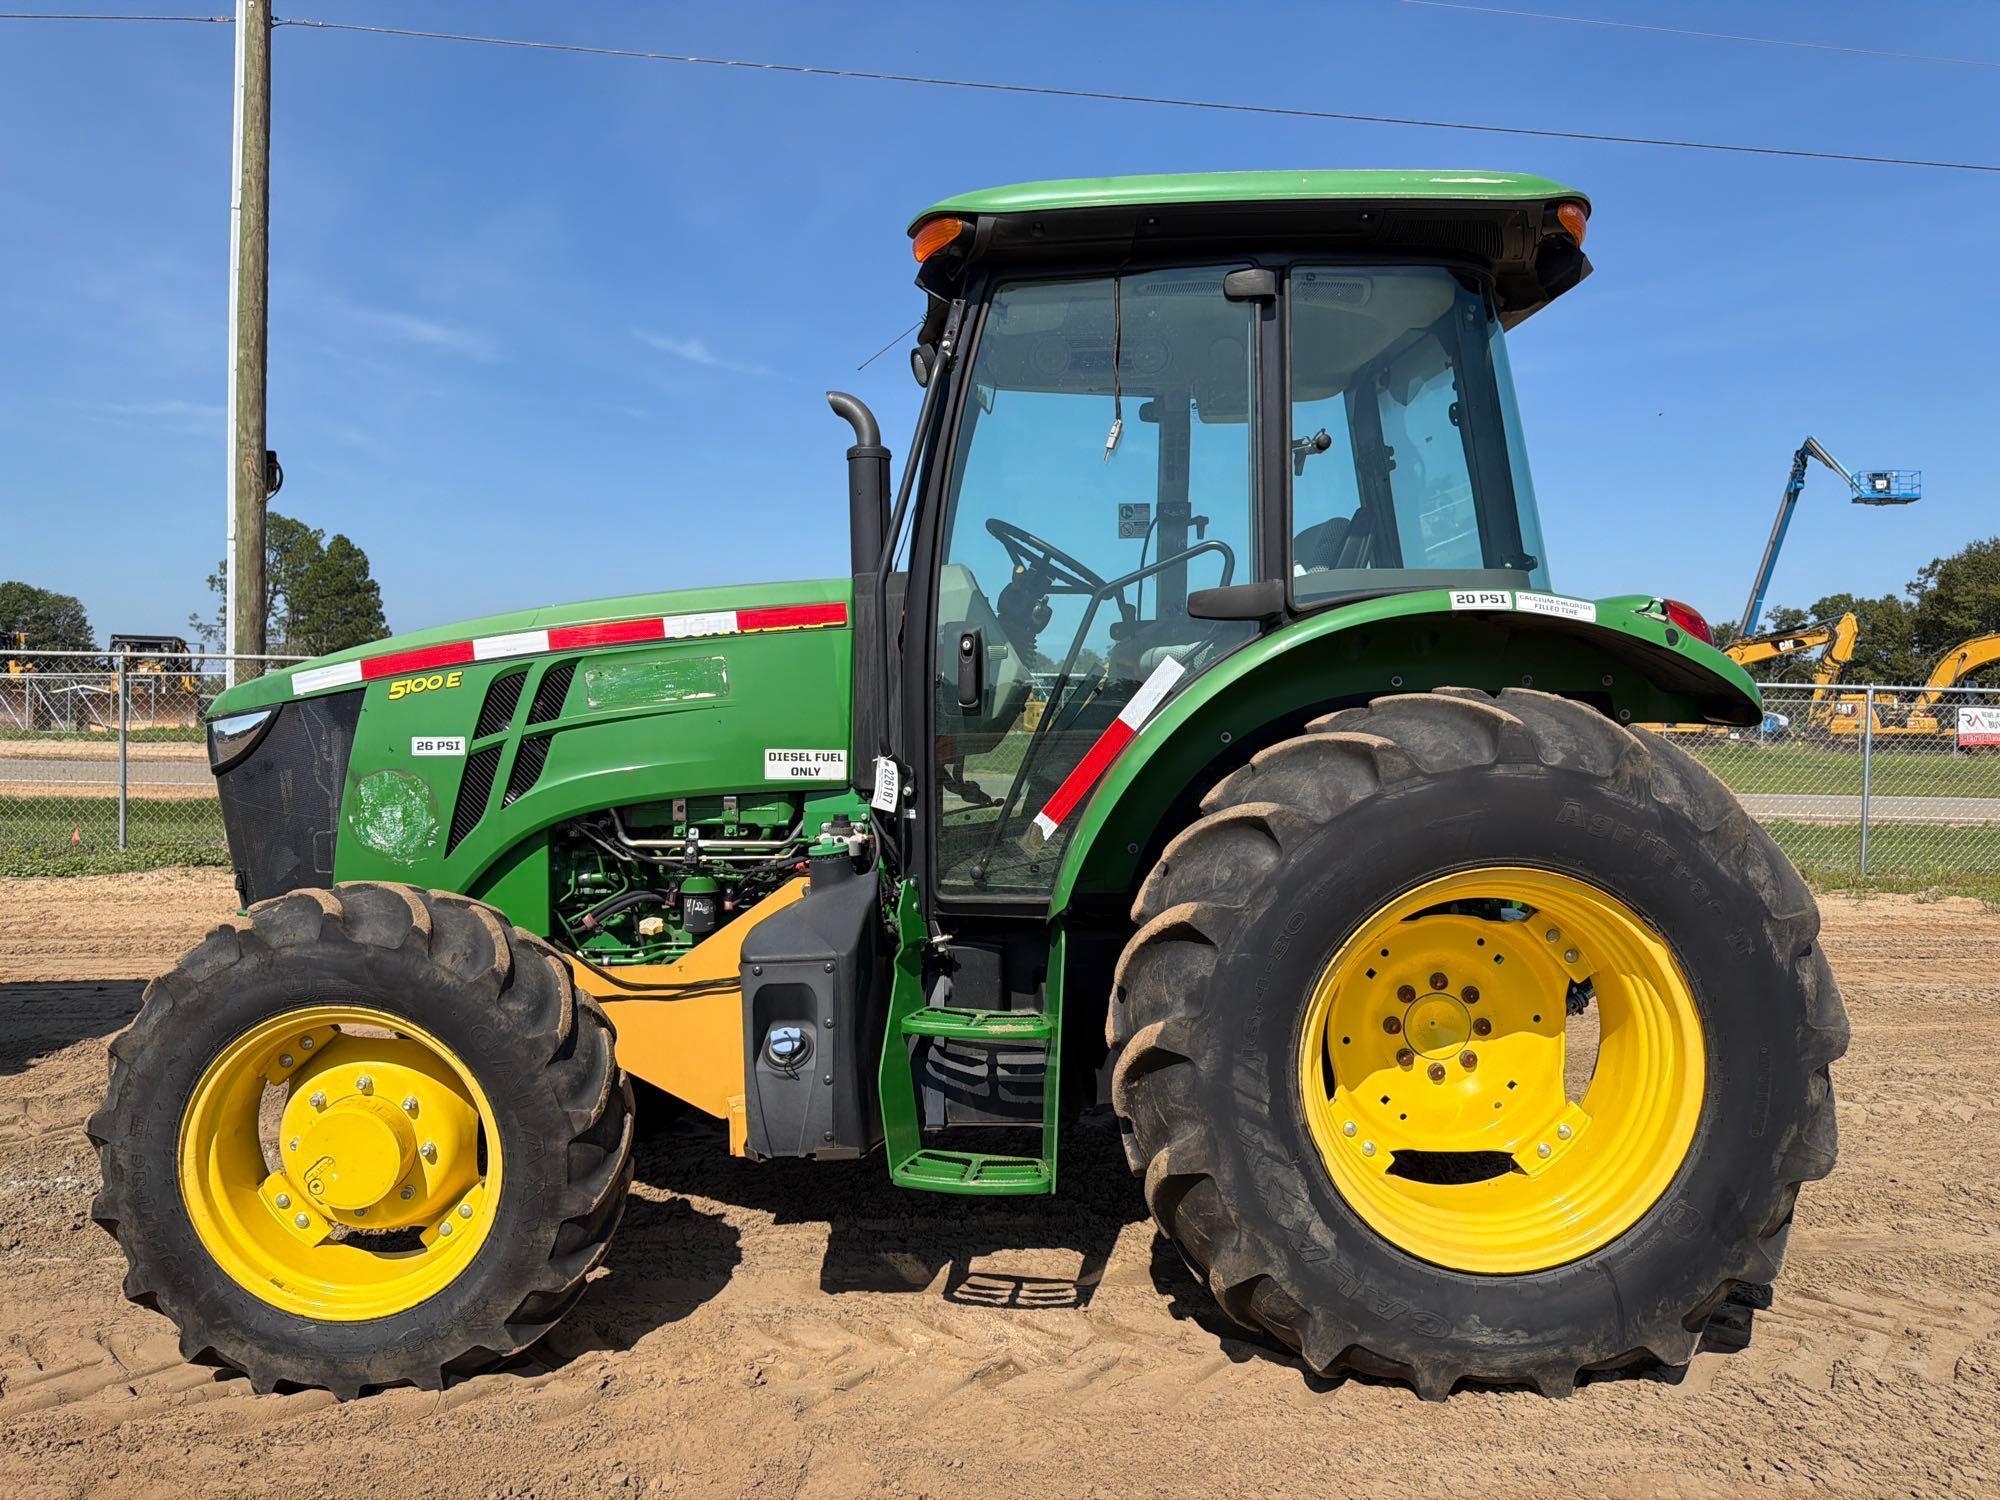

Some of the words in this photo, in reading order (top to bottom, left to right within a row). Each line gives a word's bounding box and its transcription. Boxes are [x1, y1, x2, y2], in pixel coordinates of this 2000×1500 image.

[1456, 594, 1476, 604] 20
[1480, 594, 1507, 604] PSI
[1519, 595, 1554, 605] CALCIUM
[1556, 600, 1592, 611] CHLORIDE
[1534, 603, 1560, 613] FILLED
[1561, 607, 1578, 615] TIRE
[1778, 640, 1794, 652] CAT
[388, 675, 444, 700] 5100
[446, 671, 463, 688] E
[1836, 703, 1853, 714] CAT
[416, 741, 433, 751] 26
[437, 741, 460, 751] PSI
[768, 752, 812, 762] DIESEL
[815, 753, 844, 763] FUEL
[791, 767, 821, 777] ONLY
[882, 768, 895, 805] 226187
